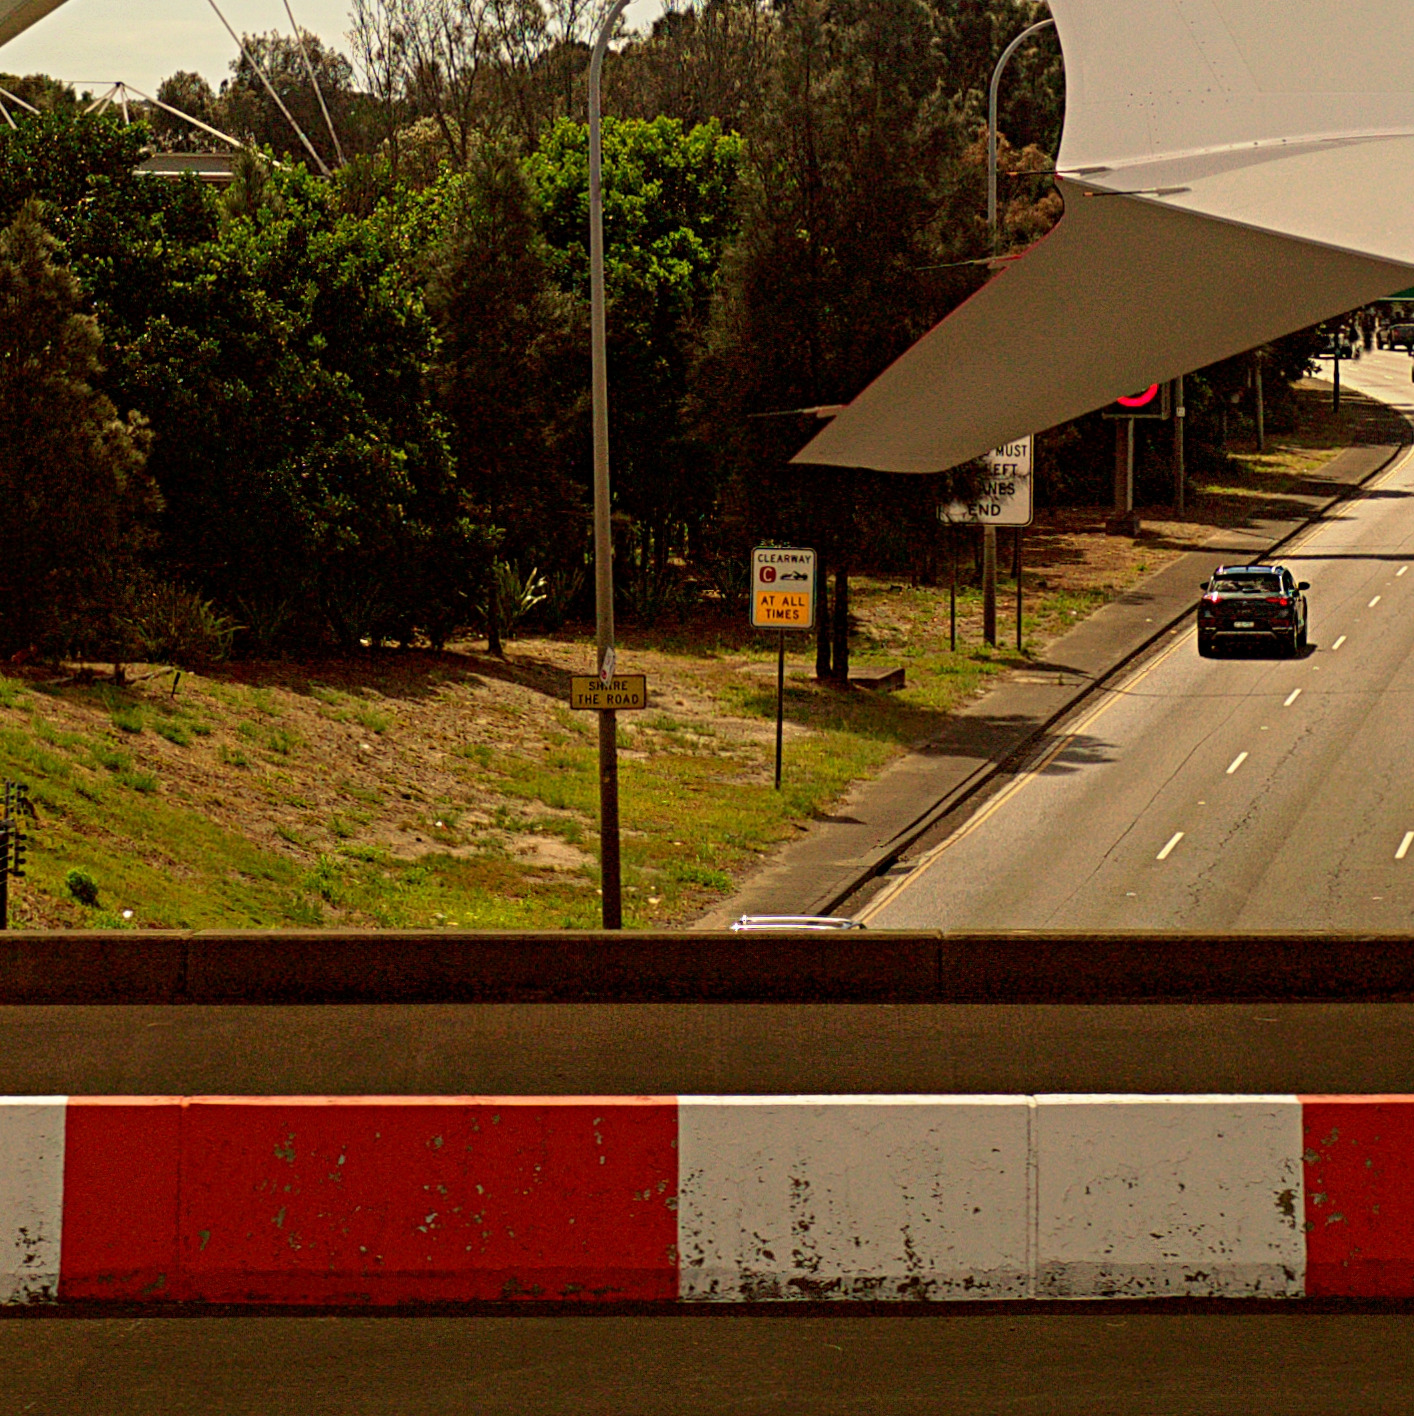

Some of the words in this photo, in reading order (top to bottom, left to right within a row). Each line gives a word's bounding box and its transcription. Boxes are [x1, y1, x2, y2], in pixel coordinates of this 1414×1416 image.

[995, 445, 1027, 457] MUST
[987, 464, 1018, 476] EFT
[968, 504, 1001, 516] END
[758, 554, 811, 563] CLEARWAY
[763, 567, 773, 582] C
[761, 596, 775, 606] AT
[782, 596, 805, 607] ALL
[766, 609, 799, 619] TIMES
[578, 694, 599, 704] THE
[607, 694, 638, 704] ROAD
